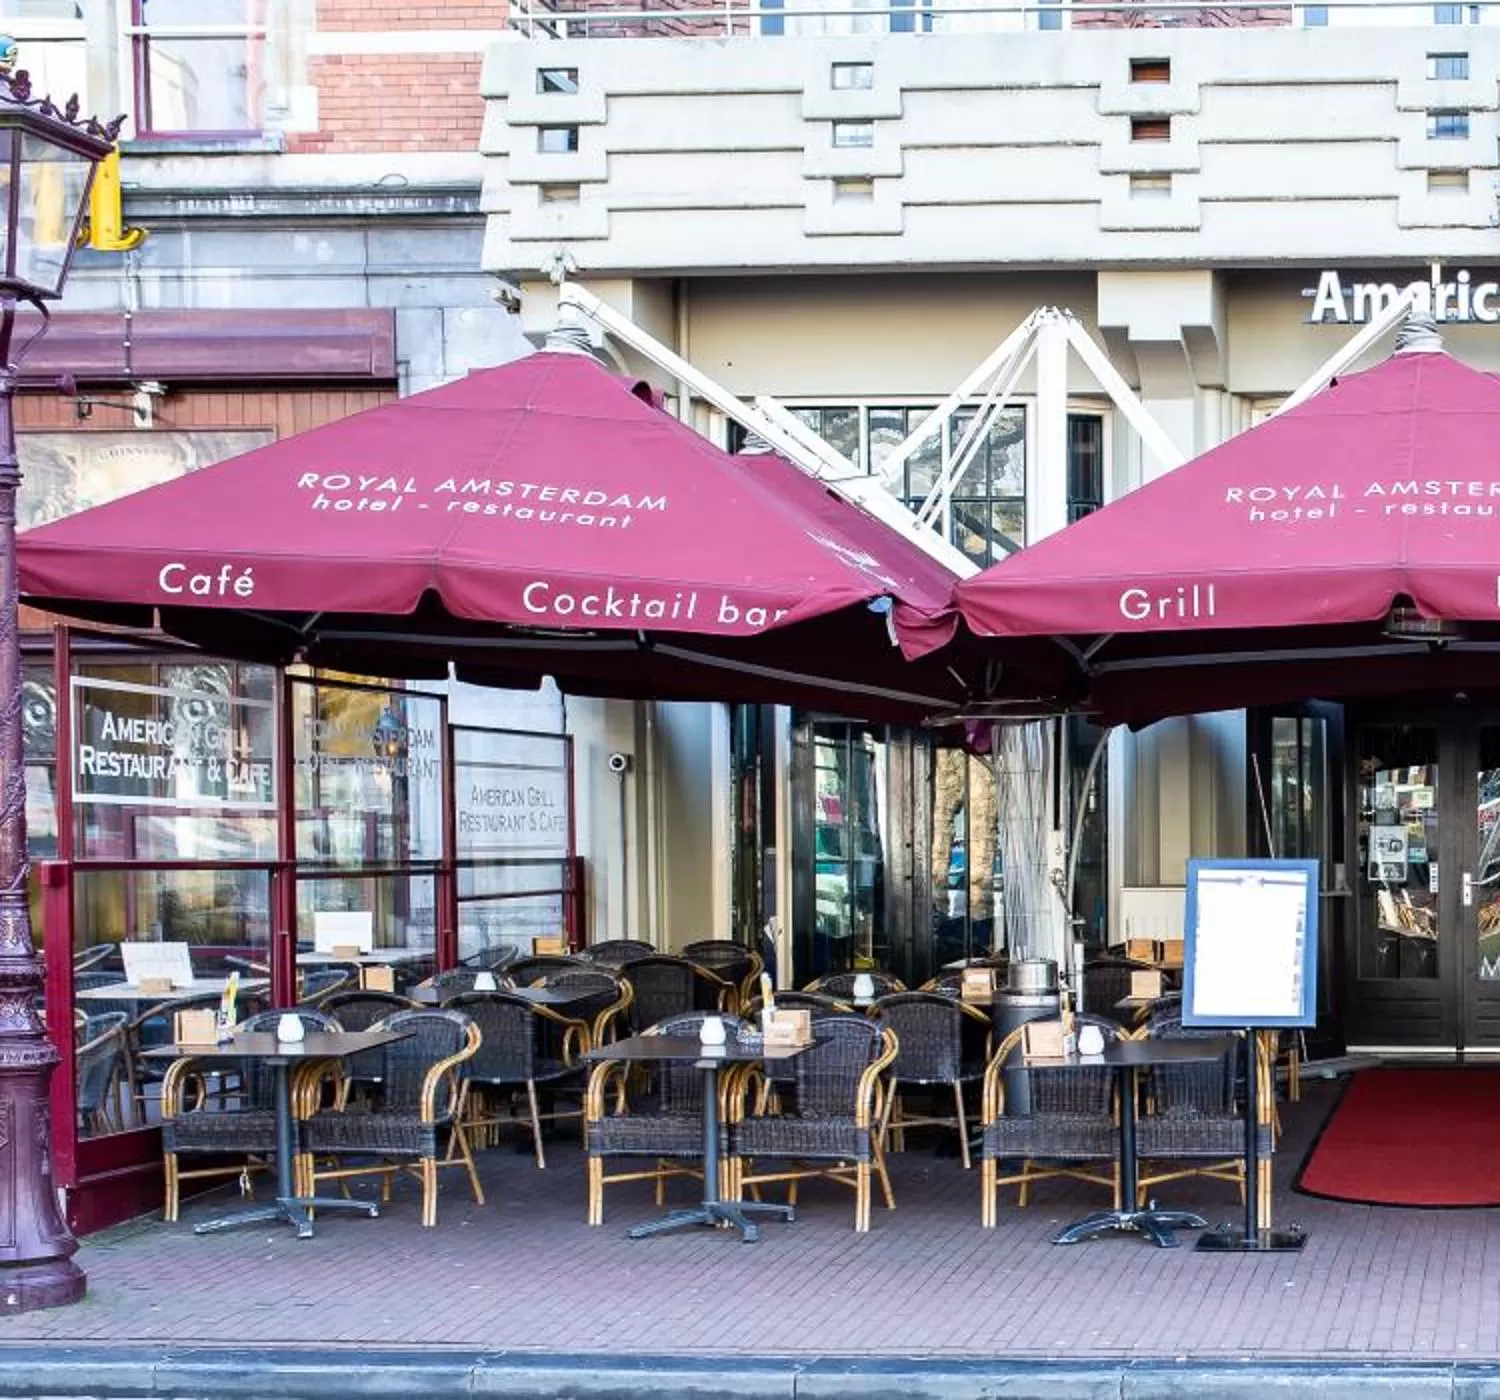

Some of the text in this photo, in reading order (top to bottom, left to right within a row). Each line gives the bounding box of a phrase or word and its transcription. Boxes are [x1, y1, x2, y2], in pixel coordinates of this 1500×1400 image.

[297, 471, 669, 513] ROYAL AMSTERDAM
[1225, 483, 1341, 503] ROYAL
[311, 494, 403, 513] hotel
[447, 499, 634, 529] restaurant
[1248, 502, 1337, 522] hotel
[158, 562, 255, 598] Café
[522, 580, 789, 627] Cocktail bar
[1118, 583, 1216, 621] Grill
[207, 756, 222, 783] &
